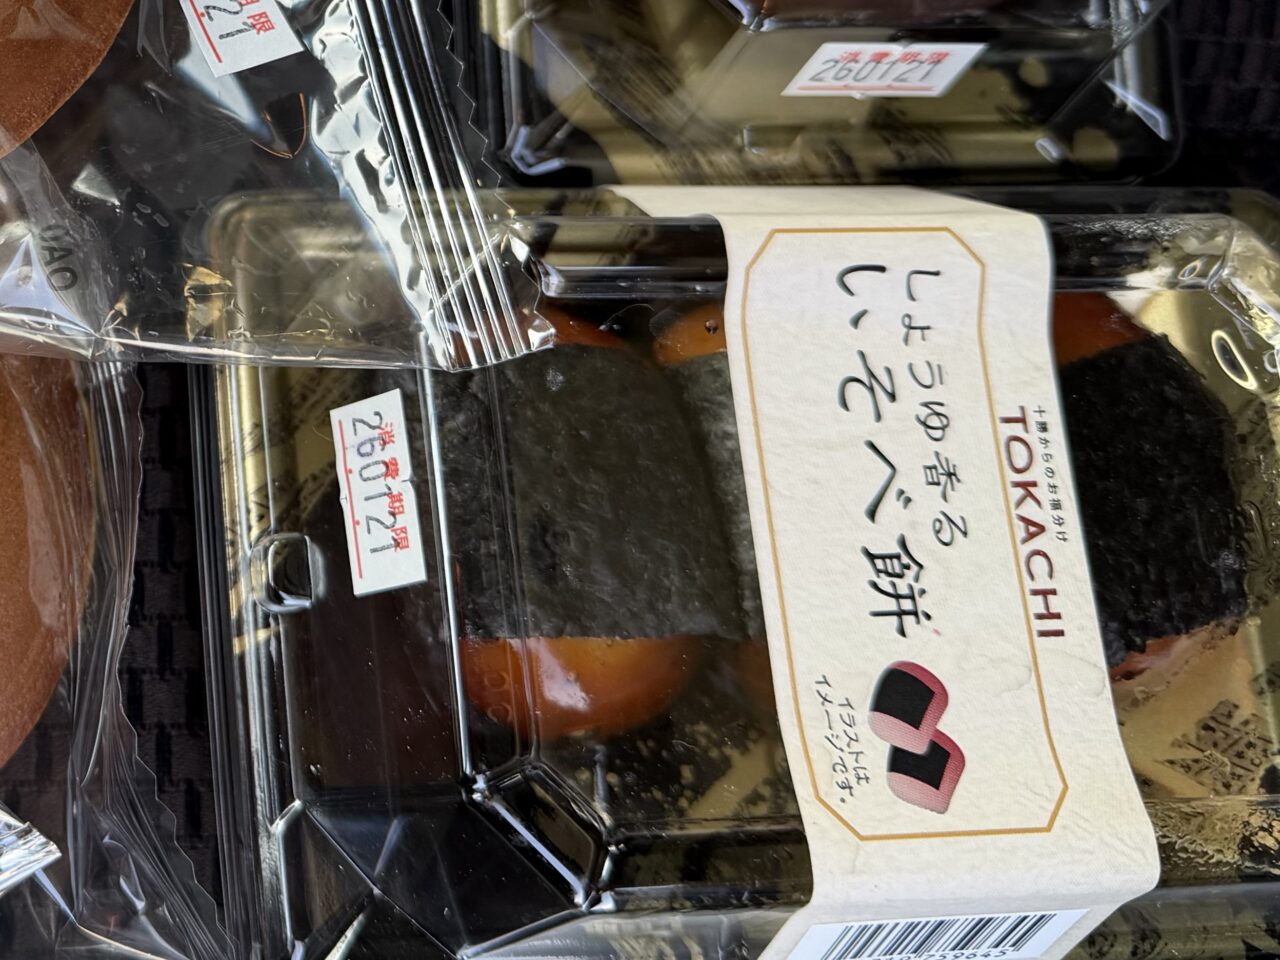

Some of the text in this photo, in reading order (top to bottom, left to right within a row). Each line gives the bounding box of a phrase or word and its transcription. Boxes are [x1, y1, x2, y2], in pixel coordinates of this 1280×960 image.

[808, 58, 941, 83] 260121
[834, 262, 932, 640] いそべ餅
[901, 268, 969, 549] しょうゆ香る
[1033, 404, 1069, 543] 十勝からのお福分け
[351, 410, 401, 555] 260121
[376, 421, 410, 552] 消費期限
[998, 404, 1066, 639] TOKACHI
[838, 697, 871, 786] イラストは
